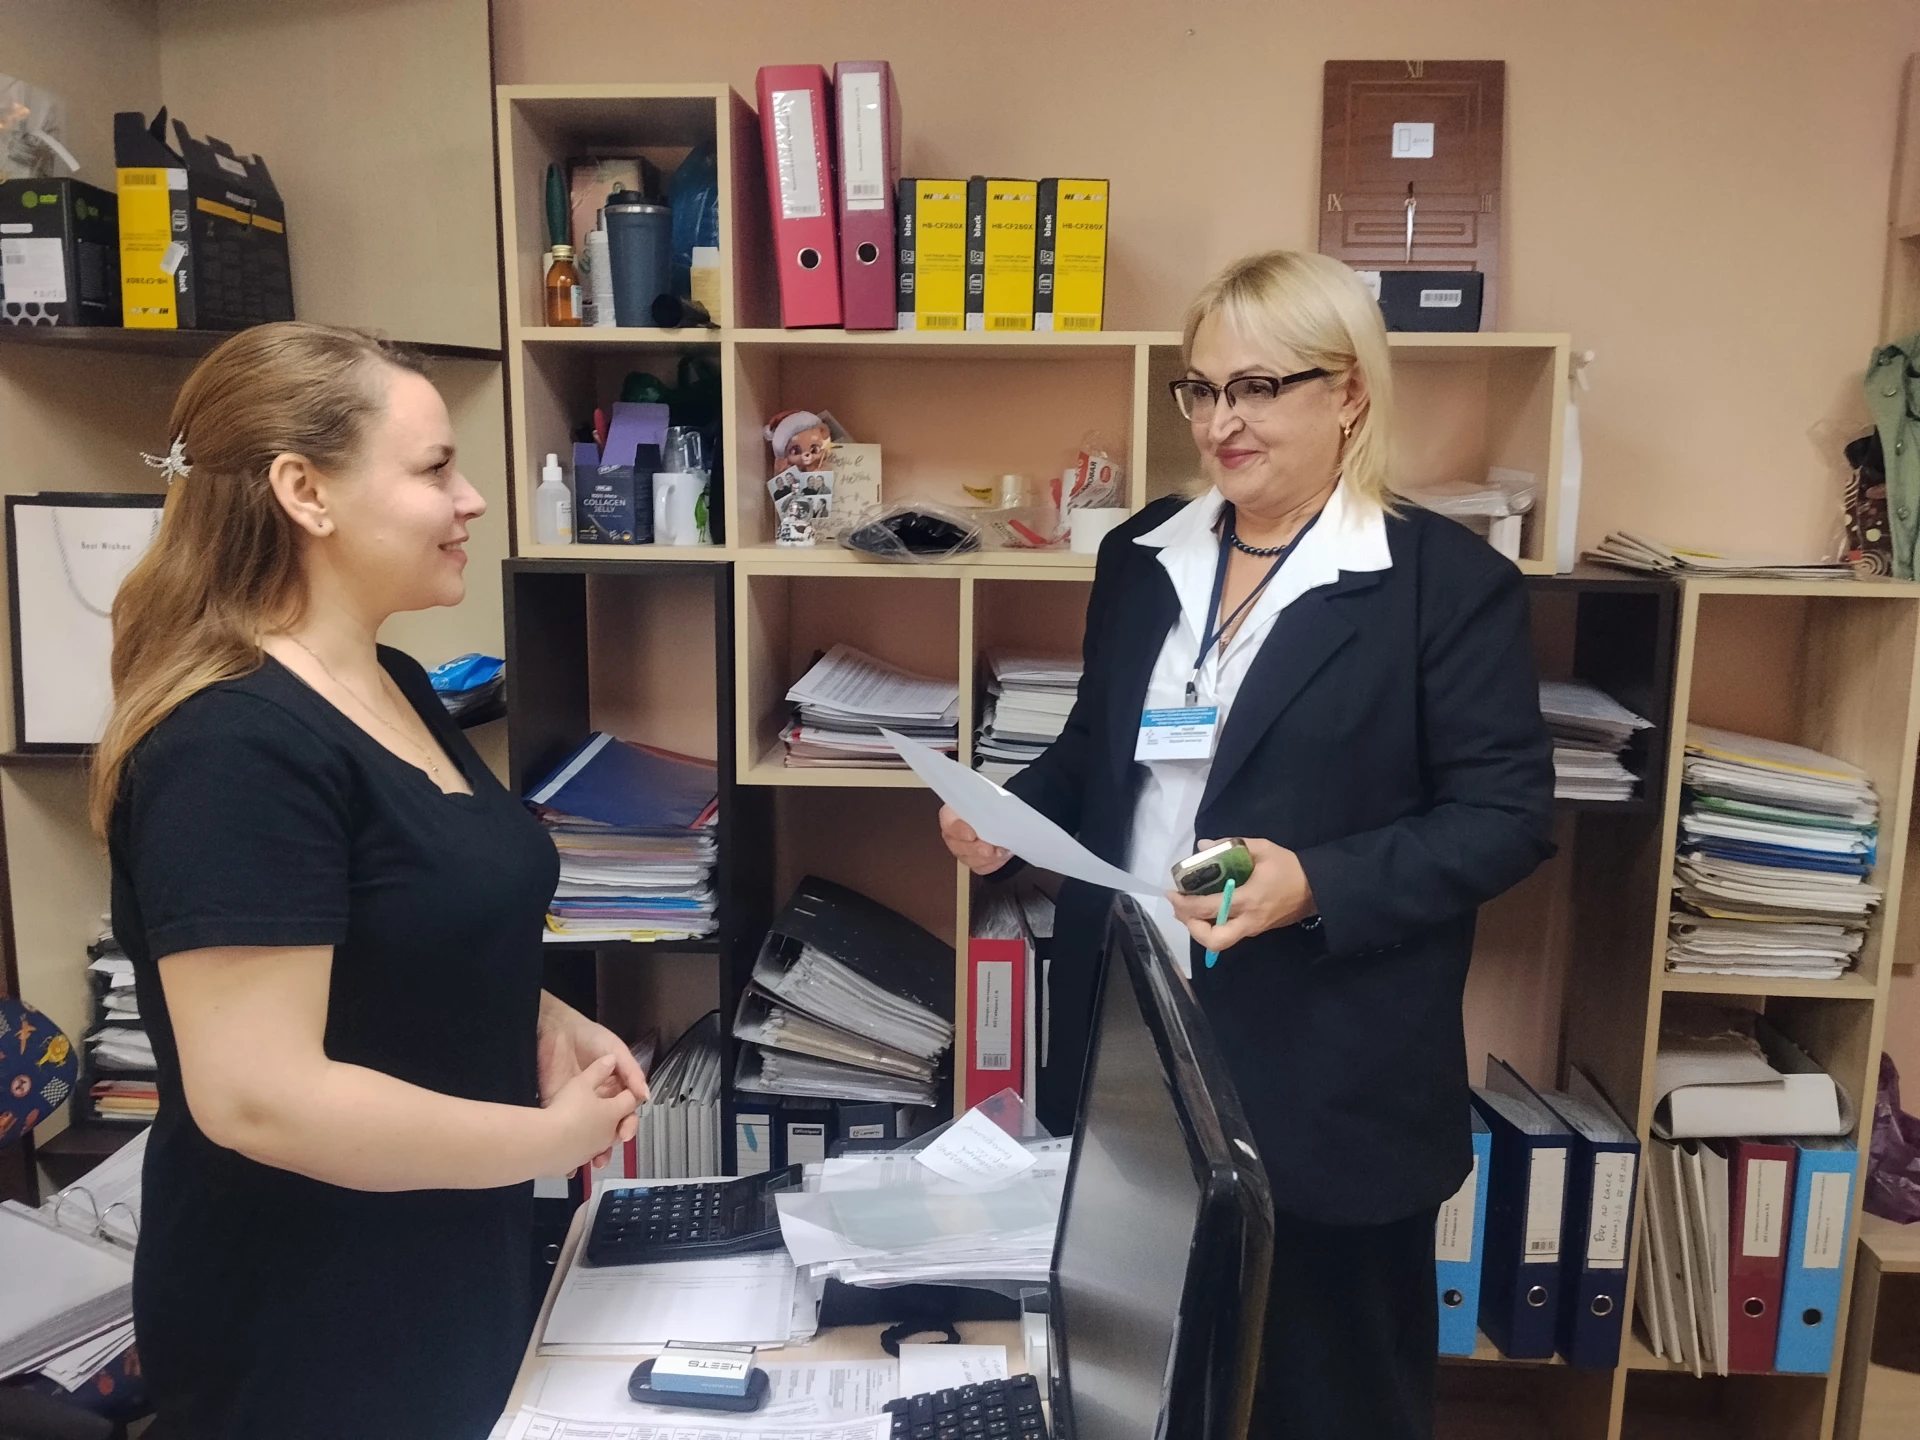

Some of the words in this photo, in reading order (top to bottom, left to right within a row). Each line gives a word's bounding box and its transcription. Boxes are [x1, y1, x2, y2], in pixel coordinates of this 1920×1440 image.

[1327, 193, 1343, 212] IX
[904, 214, 912, 237] black
[973, 214, 982, 237] black
[1044, 214, 1052, 237] black
[178, 269, 187, 293] black
[583, 497, 626, 506] COLLAGEN
[81, 541, 98, 550] Best
[102, 542, 131, 551] Wishes
[688, 1360, 742, 1371] HEETS
